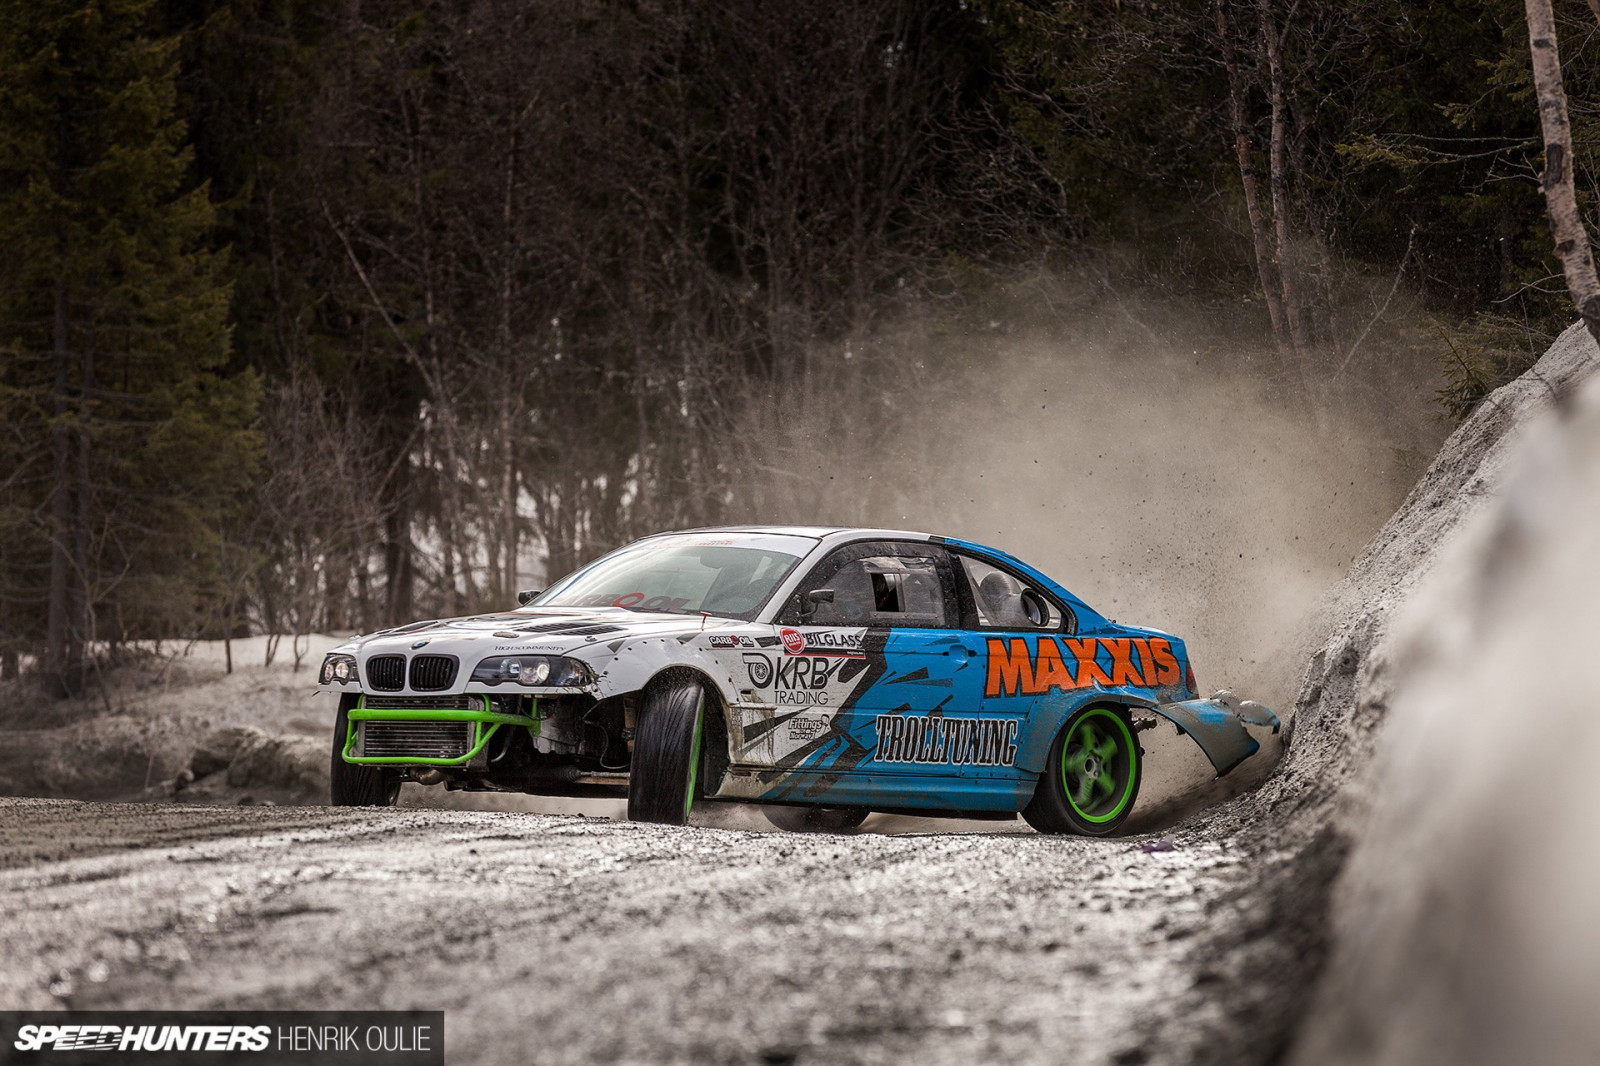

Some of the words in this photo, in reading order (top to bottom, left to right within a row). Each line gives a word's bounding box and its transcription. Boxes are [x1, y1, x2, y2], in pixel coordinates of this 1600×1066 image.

[805, 634, 863, 647] BILGLASS
[774, 656, 829, 690] KRB
[983, 636, 1181, 699] MAXXIS
[774, 690, 829, 705] TRADING
[788, 717, 823, 733] Fittings
[874, 714, 1018, 767] TROLLTUNING
